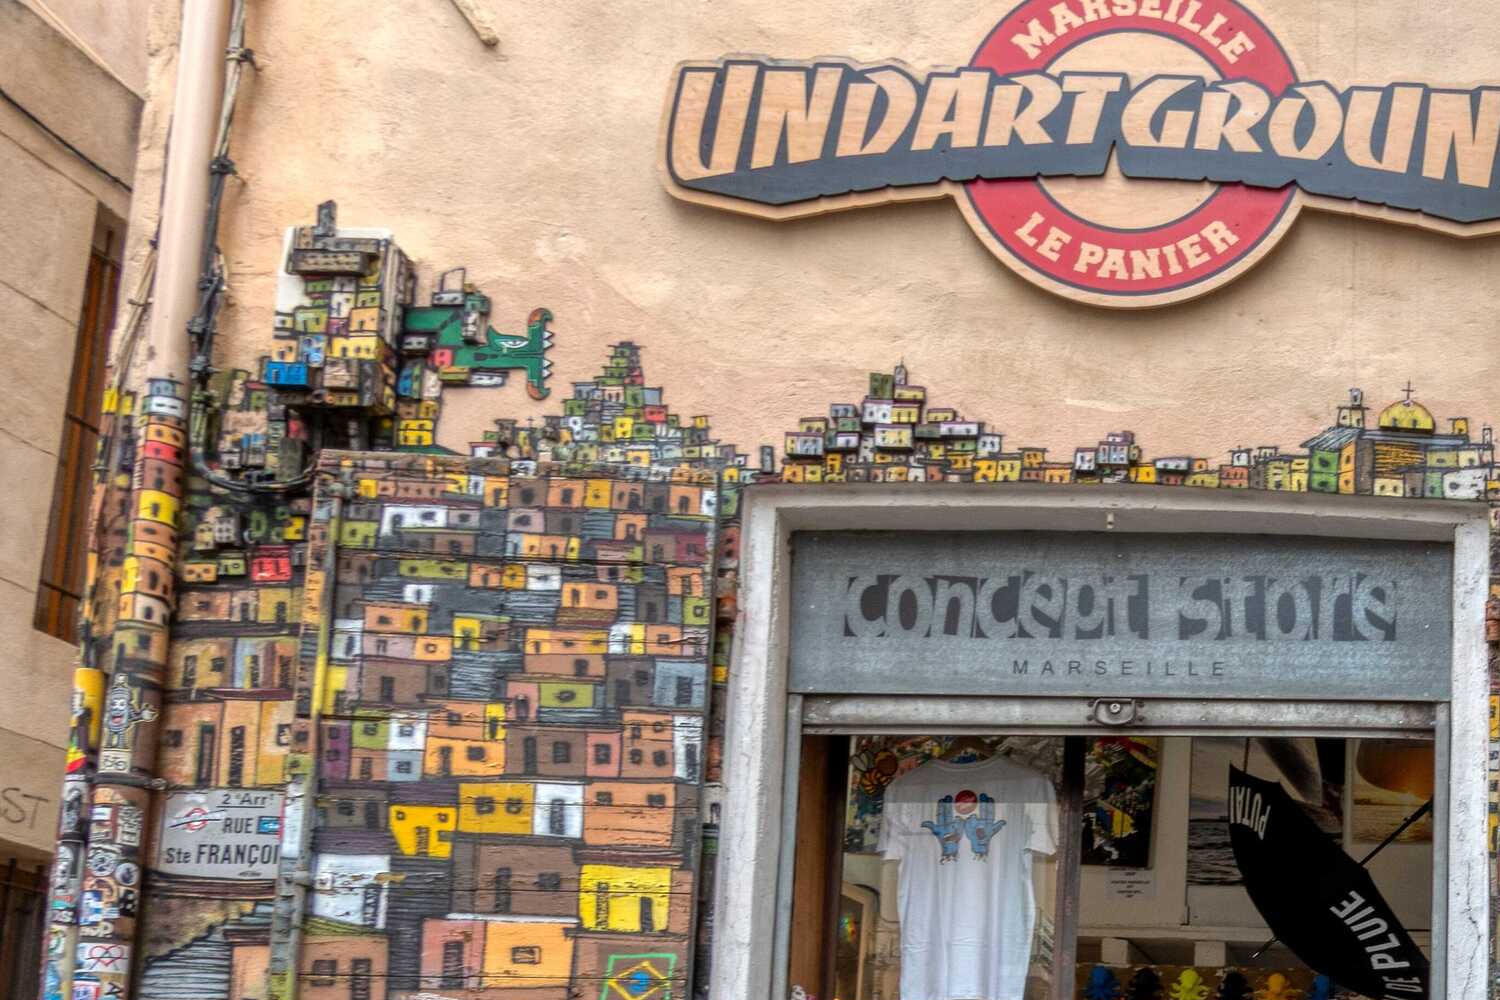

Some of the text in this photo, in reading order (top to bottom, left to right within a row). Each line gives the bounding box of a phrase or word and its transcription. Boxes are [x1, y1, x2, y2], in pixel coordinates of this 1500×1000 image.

[1010, 0, 1256, 64] MARSEILLE
[1015, 212, 1240, 280] LE PANIER
[1013, 659, 1225, 677] MARSEILLE
[222, 818, 253, 834] RUE
[166, 847, 191, 864] Ste
[1329, 890, 1411, 970] PLUIE
